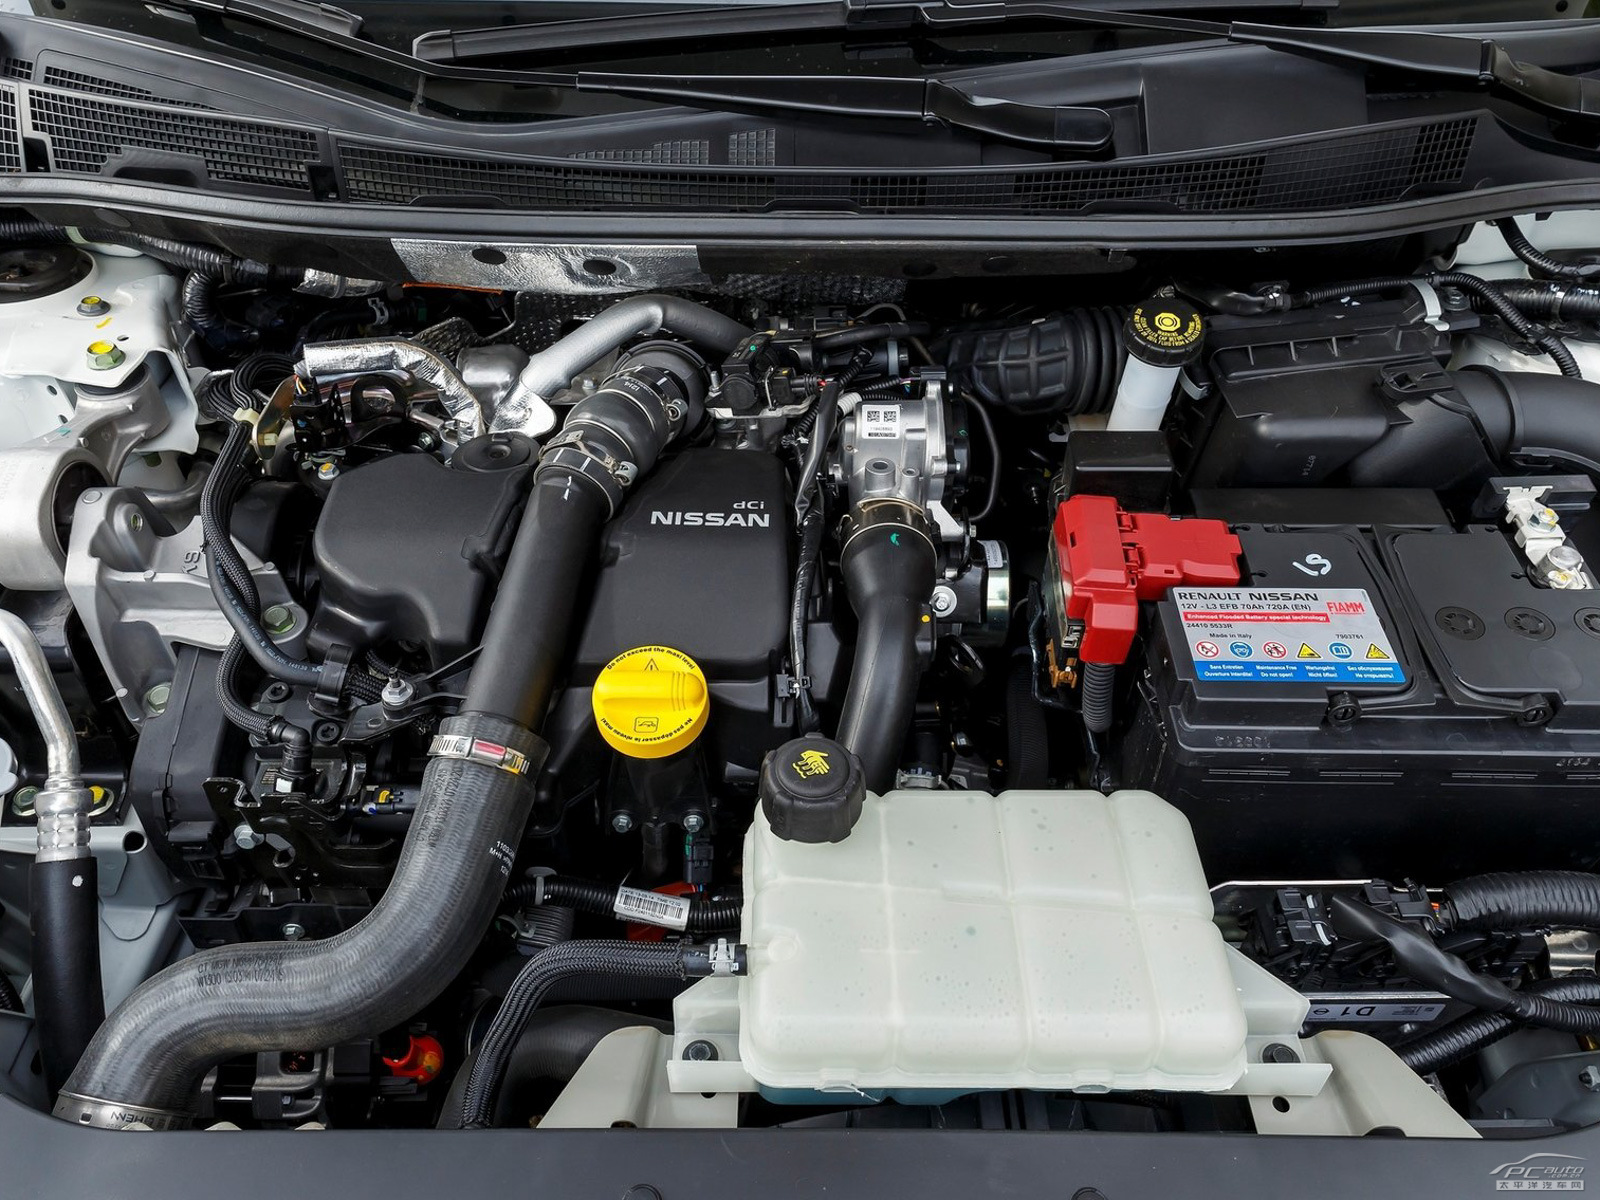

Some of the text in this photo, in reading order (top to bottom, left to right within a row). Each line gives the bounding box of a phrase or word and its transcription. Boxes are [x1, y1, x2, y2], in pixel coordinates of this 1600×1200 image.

[733, 501, 764, 509] dCi
[650, 511, 770, 527] NISSAN
[1248, 592, 1318, 601] NISSAN
[1326, 602, 1365, 612] FIAMM
[606, 662, 615, 670] Do
[616, 654, 627, 663] not
[627, 647, 652, 656] exceed
[666, 650, 682, 660] maxi
[682, 656, 695, 670] level
[600, 718, 613, 730] maxi
[684, 718, 693, 726] Ne
[673, 724, 684, 734] pas
[612, 729, 633, 741] niveau
[642, 732, 673, 742] dépasser
